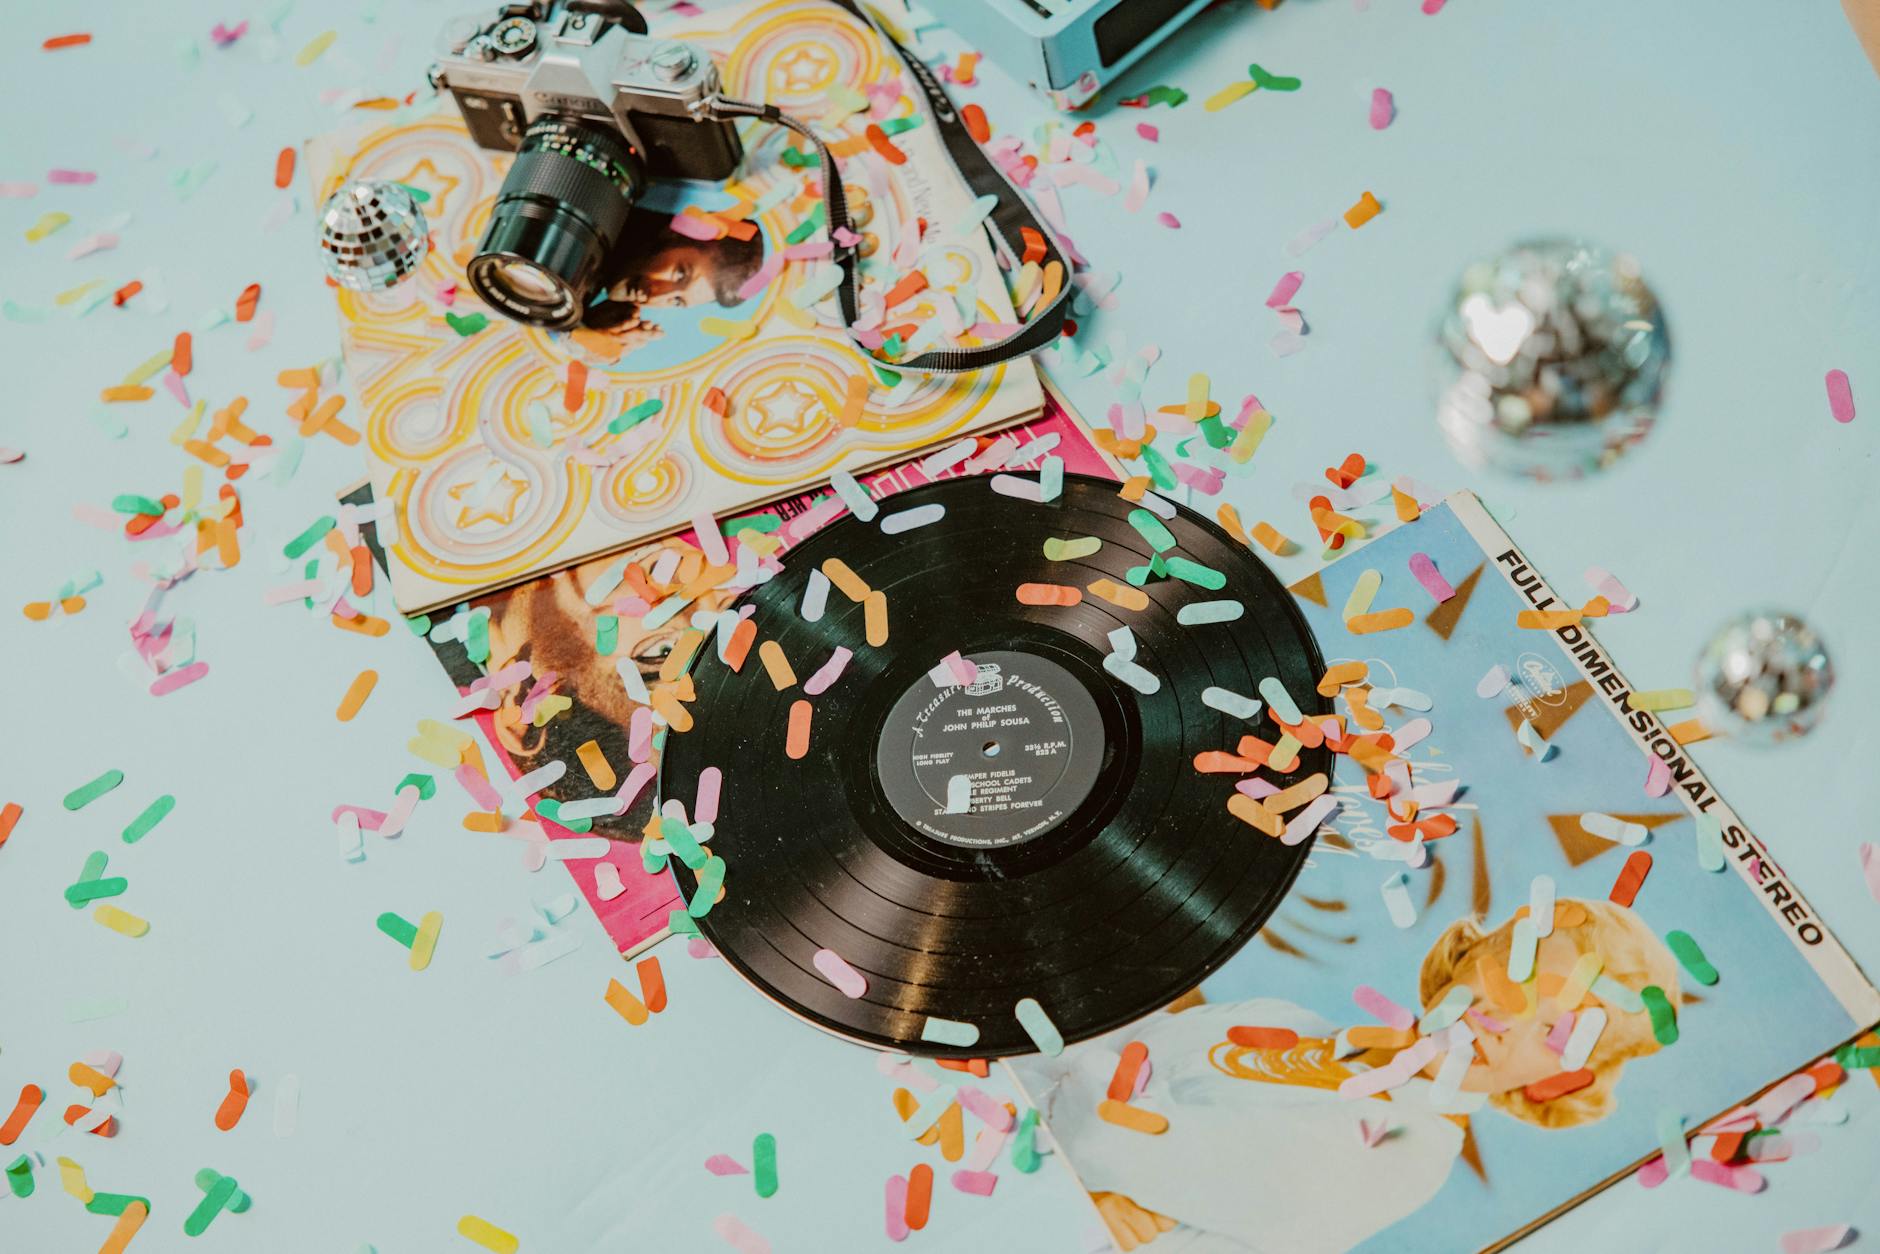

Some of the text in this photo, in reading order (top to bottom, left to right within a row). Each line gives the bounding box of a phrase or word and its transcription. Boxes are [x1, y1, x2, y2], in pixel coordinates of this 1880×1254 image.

[957, 704, 1017, 717] THE MARCHES
[942, 717, 1031, 732] JOHN PHILIP SOUSA
[1043, 741, 1067, 749] R.P.M.
[1496, 549, 1823, 945] FULL DIMENSIONAL STEREO
[990, 769, 1015, 778] FIDELIS
[1003, 776, 1032, 785] CADETS
[980, 785, 1017, 795] REGIMENT
[995, 794, 1012, 802] BELL
[980, 803, 1008, 812] STRIPES
[1011, 800, 1043, 809] FOREVER
